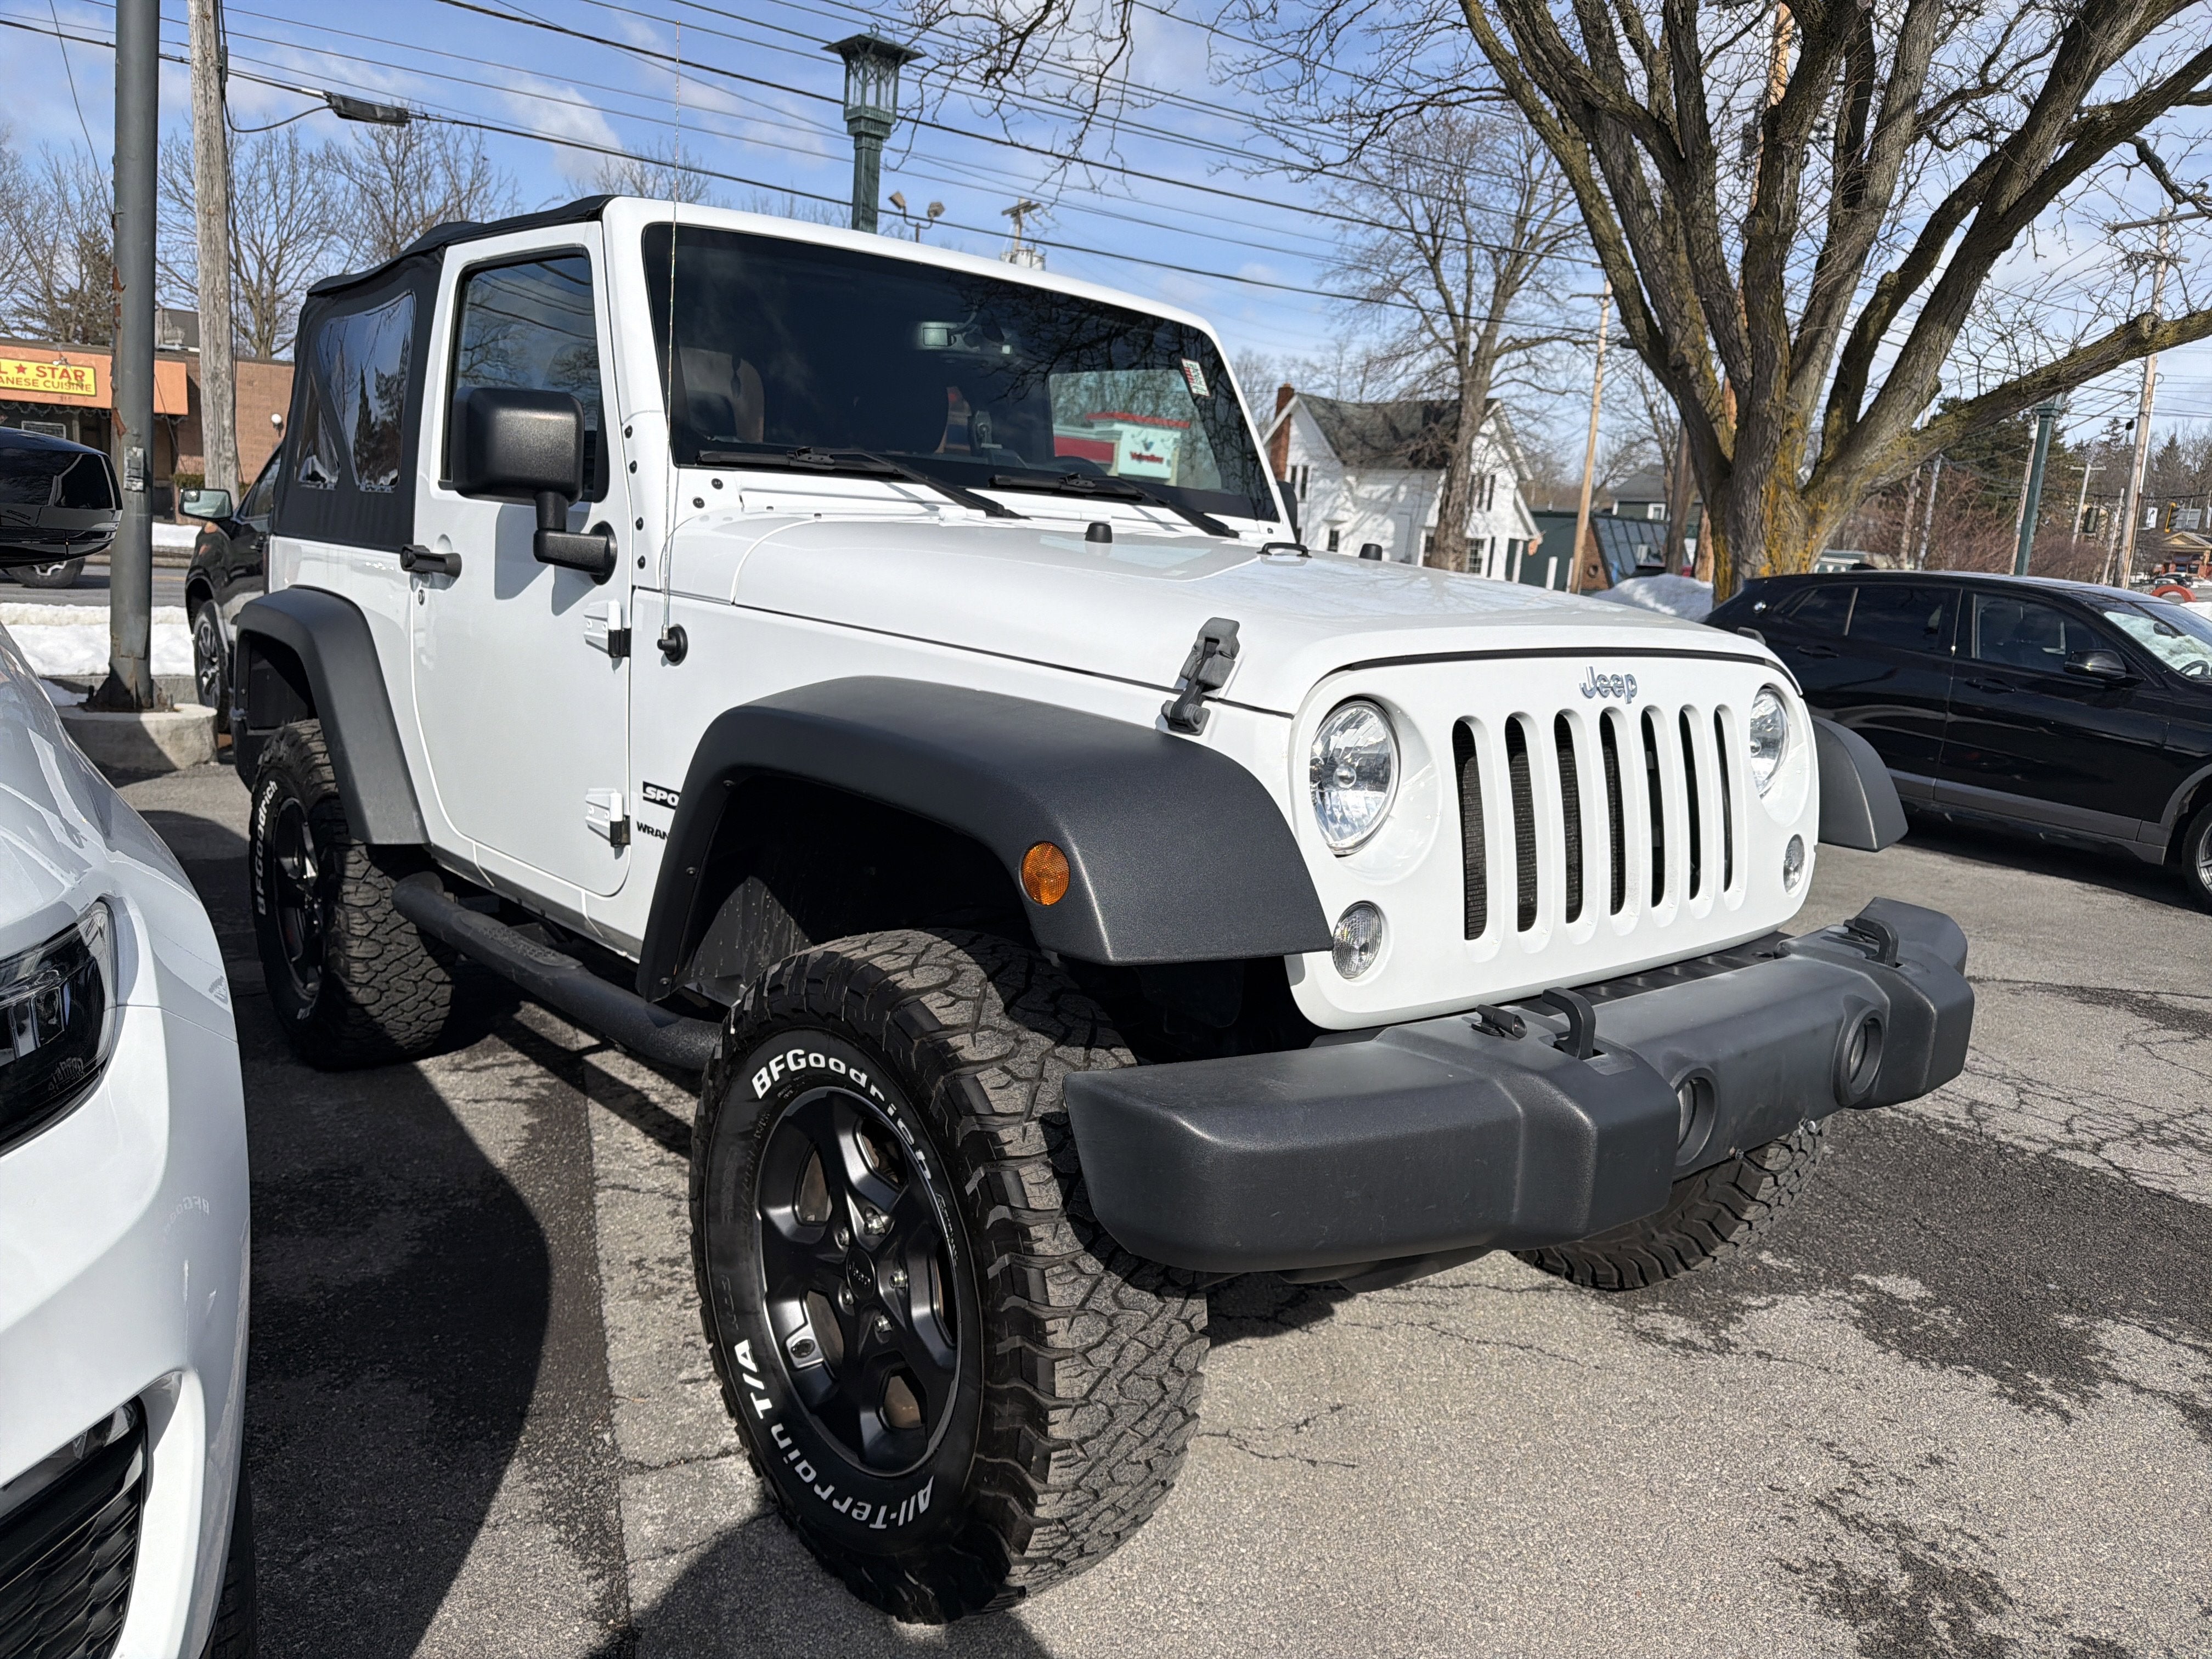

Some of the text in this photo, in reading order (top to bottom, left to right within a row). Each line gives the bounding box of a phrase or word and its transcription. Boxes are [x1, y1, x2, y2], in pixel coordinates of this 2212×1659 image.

[36, 365, 86, 382] STAR
[43, 379, 92, 392] CUISINE
[1579, 666, 1638, 704] Jeep
[643, 786, 680, 806] SPO
[751, 1048, 932, 1180] BFGoodrich
[734, 1339, 935, 1529] All-Terrain T/A
